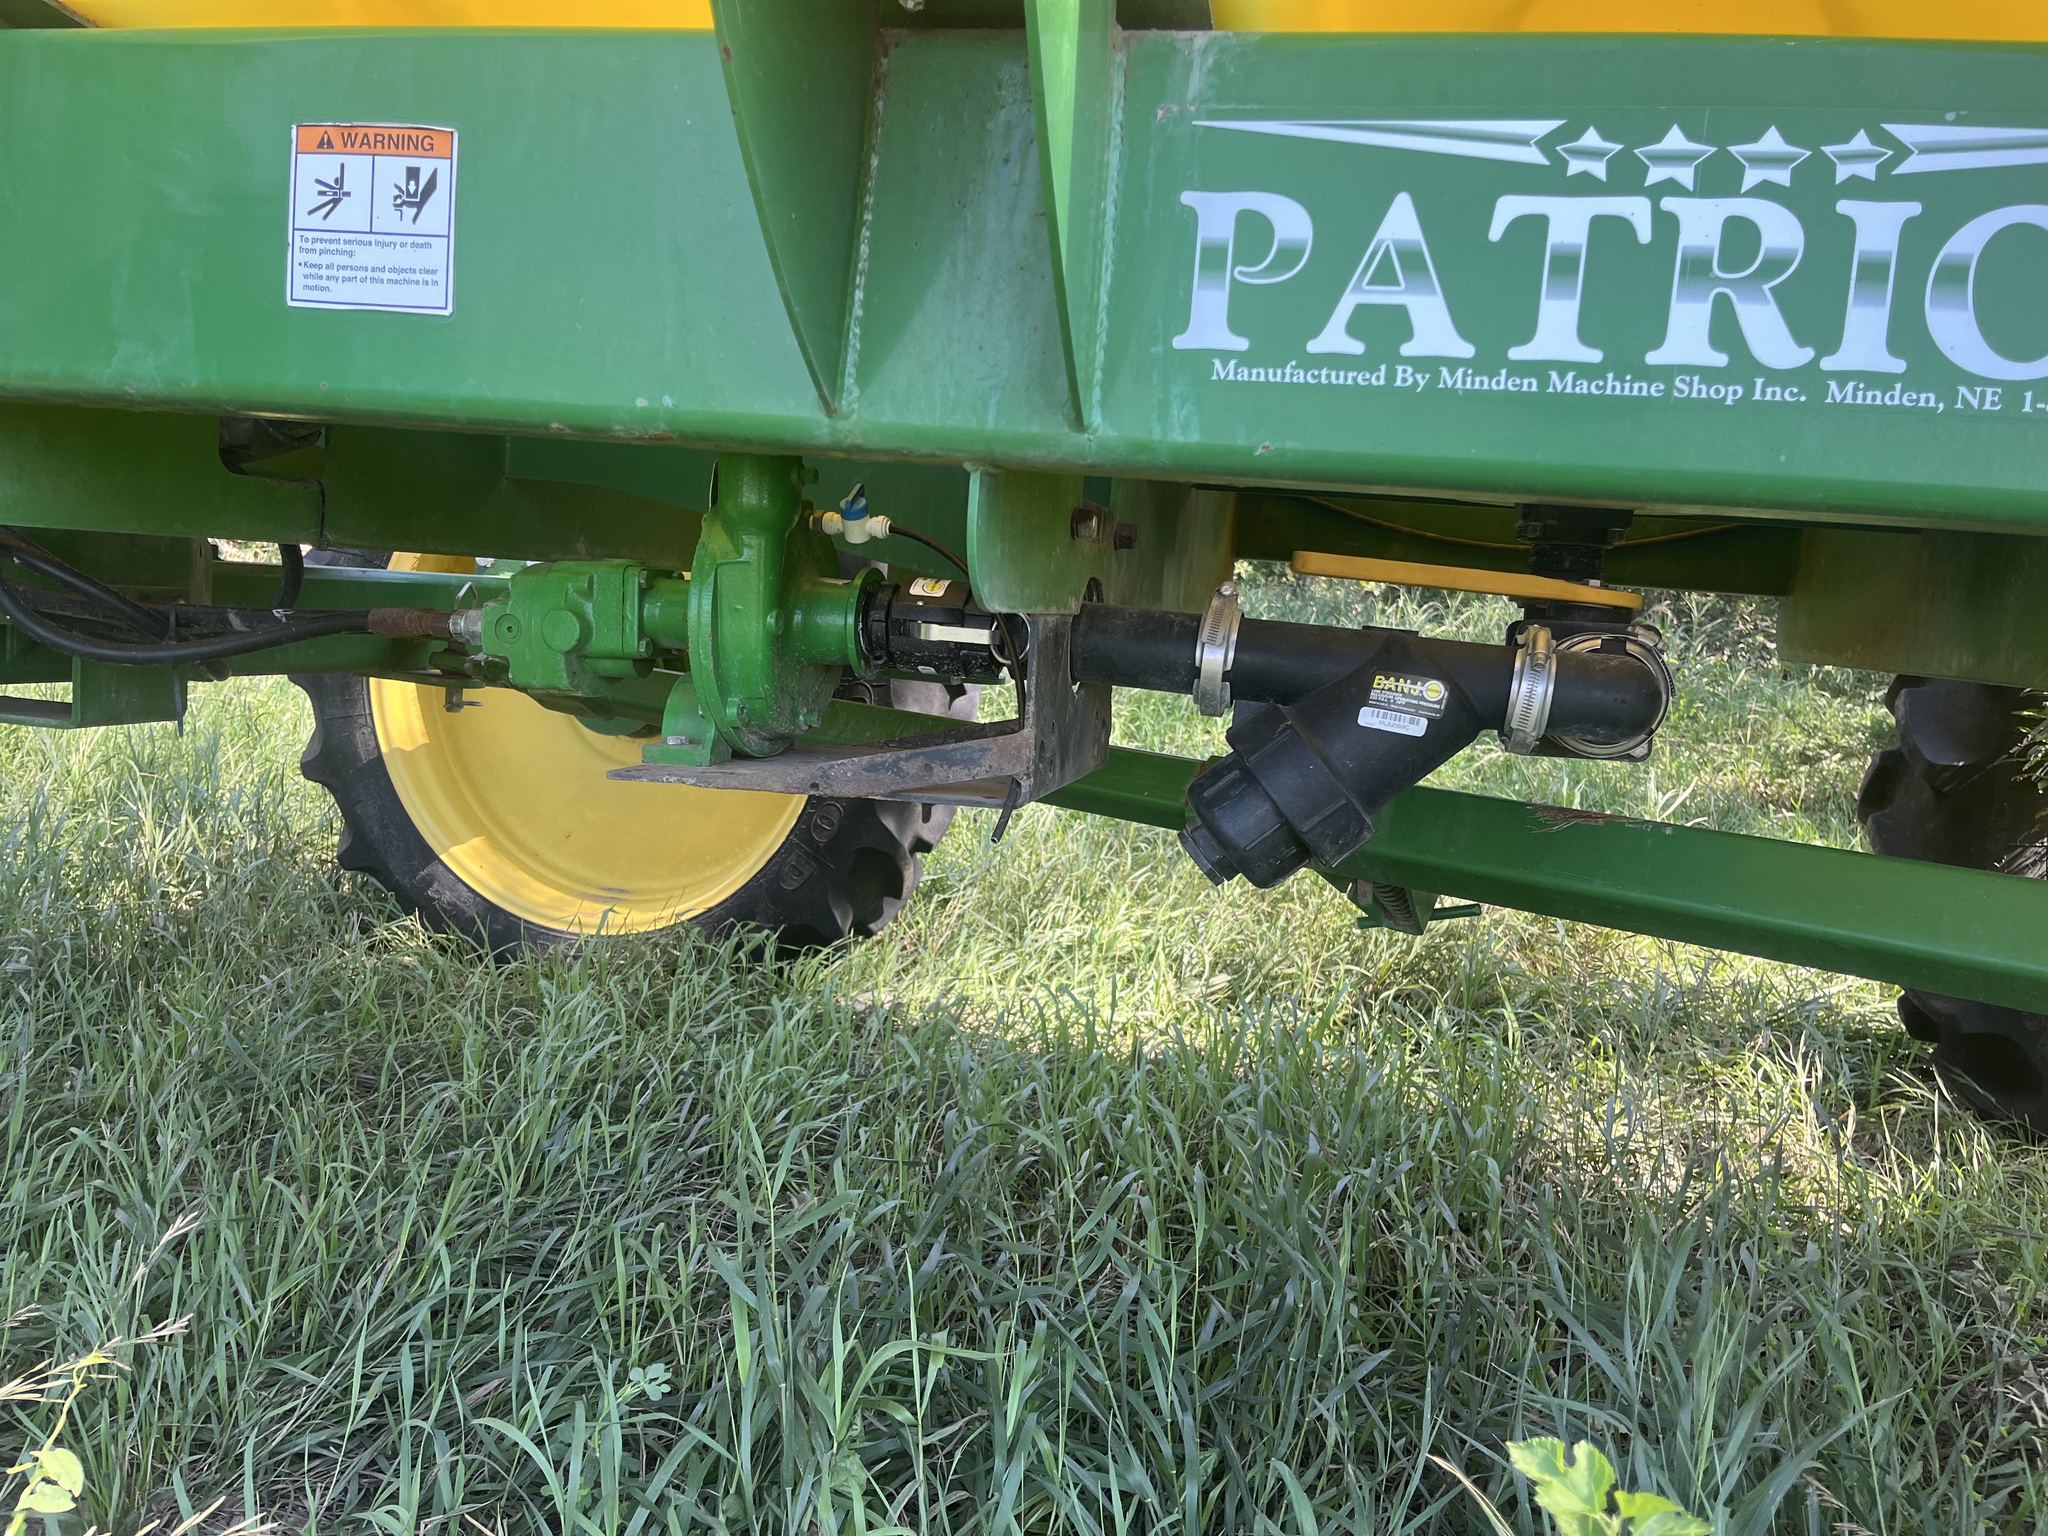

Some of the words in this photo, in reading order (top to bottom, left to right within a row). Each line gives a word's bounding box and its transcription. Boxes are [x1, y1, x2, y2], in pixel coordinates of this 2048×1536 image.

[341, 132, 435, 152] WARNING
[299, 235, 309, 243] To
[311, 236, 341, 246] prevent
[342, 237, 372, 247] serious
[374, 239, 397, 250] injury
[410, 241, 432, 250] death
[299, 246, 317, 255] from
[319, 247, 356, 259] pinching:
[303, 261, 323, 271] Keep
[325, 262, 334, 270] all
[336, 264, 369, 274] persons
[371, 265, 386, 274] and
[388, 266, 417, 277] objects
[418, 267, 439, 276] clear
[303, 273, 323, 281] while
[325, 274, 340, 285] any
[342, 275, 358, 284] part
[359, 275, 368, 284] of
[369, 276, 385, 285] this
[386, 277, 420, 287] machine
[422, 278, 430, 287] is
[430, 279, 439, 287] in
[303, 284, 332, 294] motion.
[1211, 358, 1386, 387] Manufactured
[1393, 364, 1431, 393] By
[1437, 366, 1538, 392] Minden
[1547, 370, 1665, 397] Machine
[1673, 374, 1743, 405] Shop
[1751, 378, 1807, 403] Inc.
[1824, 380, 1945, 414] Minden,
[1954, 386, 2002, 411] NE
[2021, 390, 2048, 413] 1-
